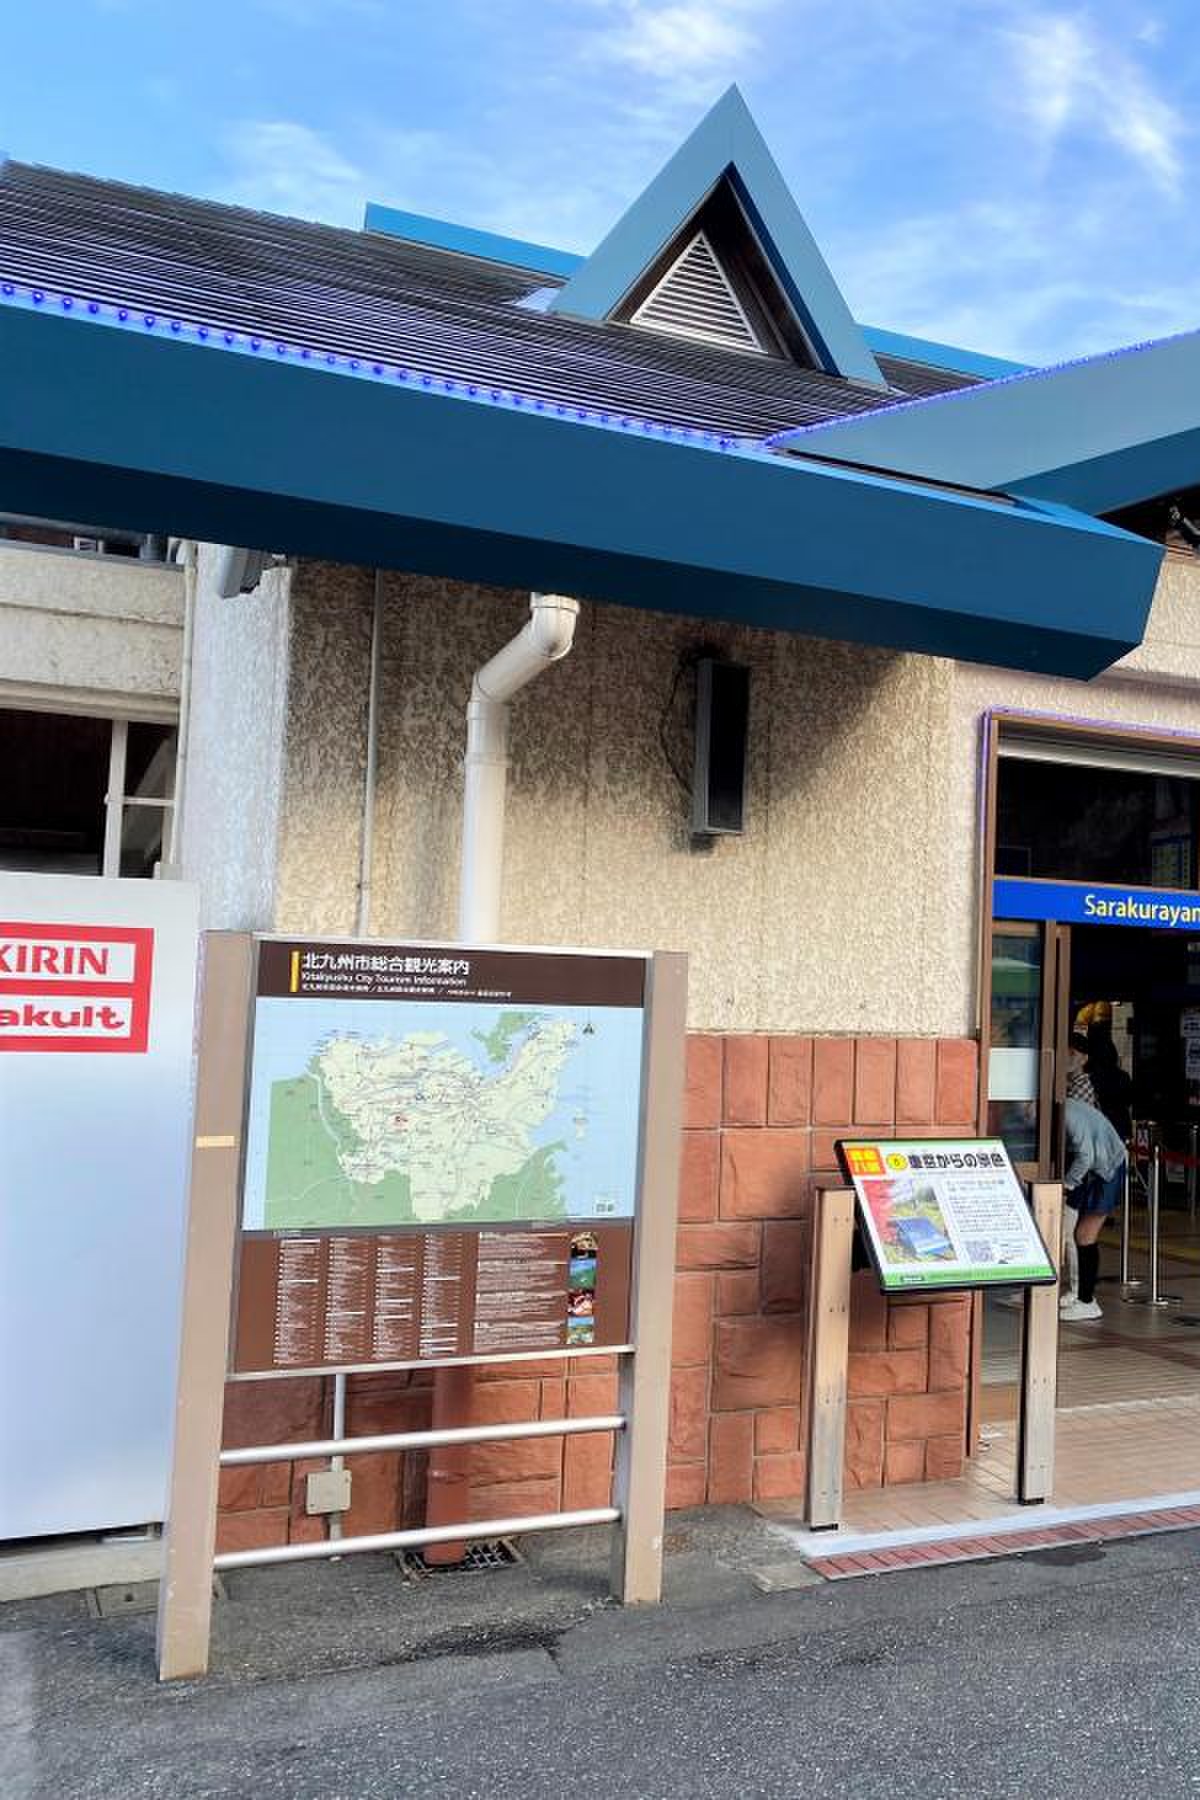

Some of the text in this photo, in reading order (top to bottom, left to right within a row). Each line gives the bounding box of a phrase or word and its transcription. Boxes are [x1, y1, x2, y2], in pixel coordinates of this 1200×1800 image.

[302, 952, 470, 976] 北九州市総合観光案内
[0, 1003, 125, 1029] akult
